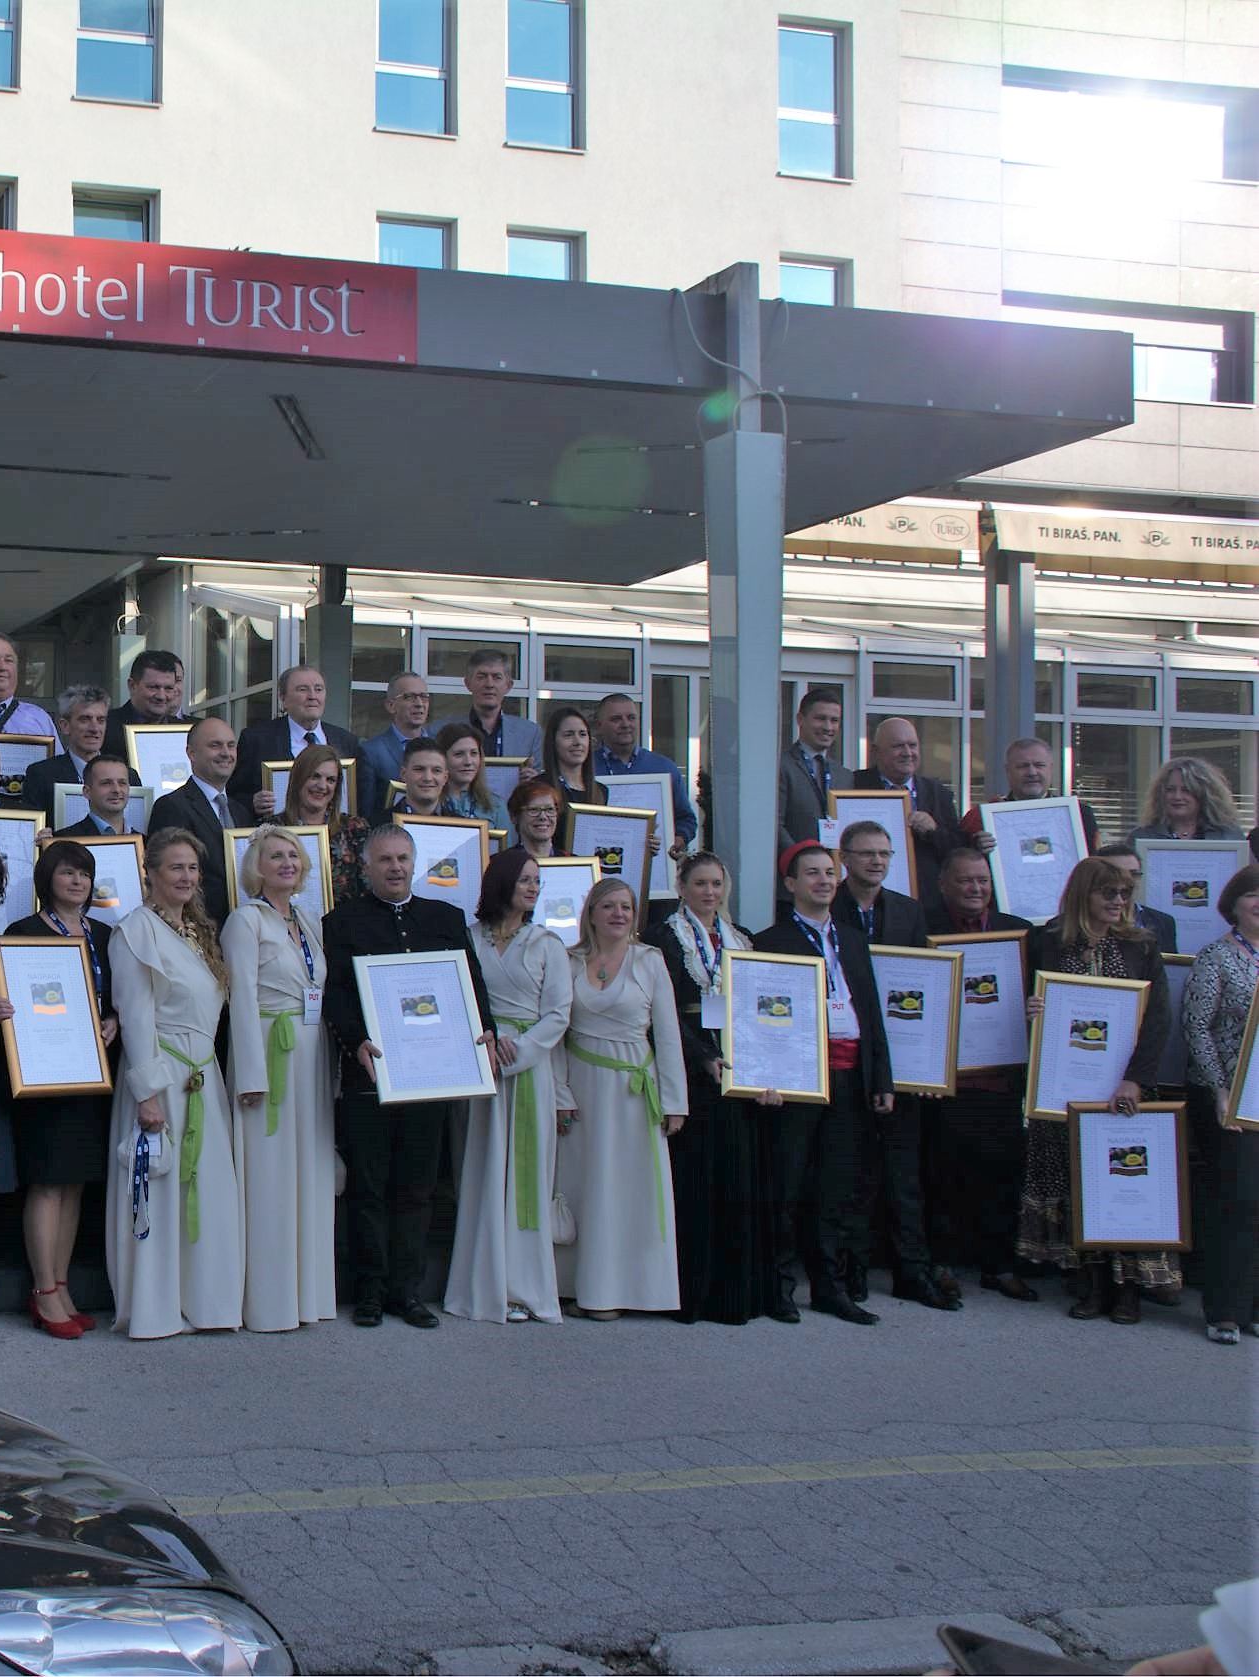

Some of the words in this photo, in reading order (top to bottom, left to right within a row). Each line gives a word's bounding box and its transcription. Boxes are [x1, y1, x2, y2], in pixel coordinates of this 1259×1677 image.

[1038, 526, 1049, 538] TI
[1093, 530, 1122, 543] PAN.
[1191, 536, 1202, 547] TI
[309, 993, 319, 1001] PUT
